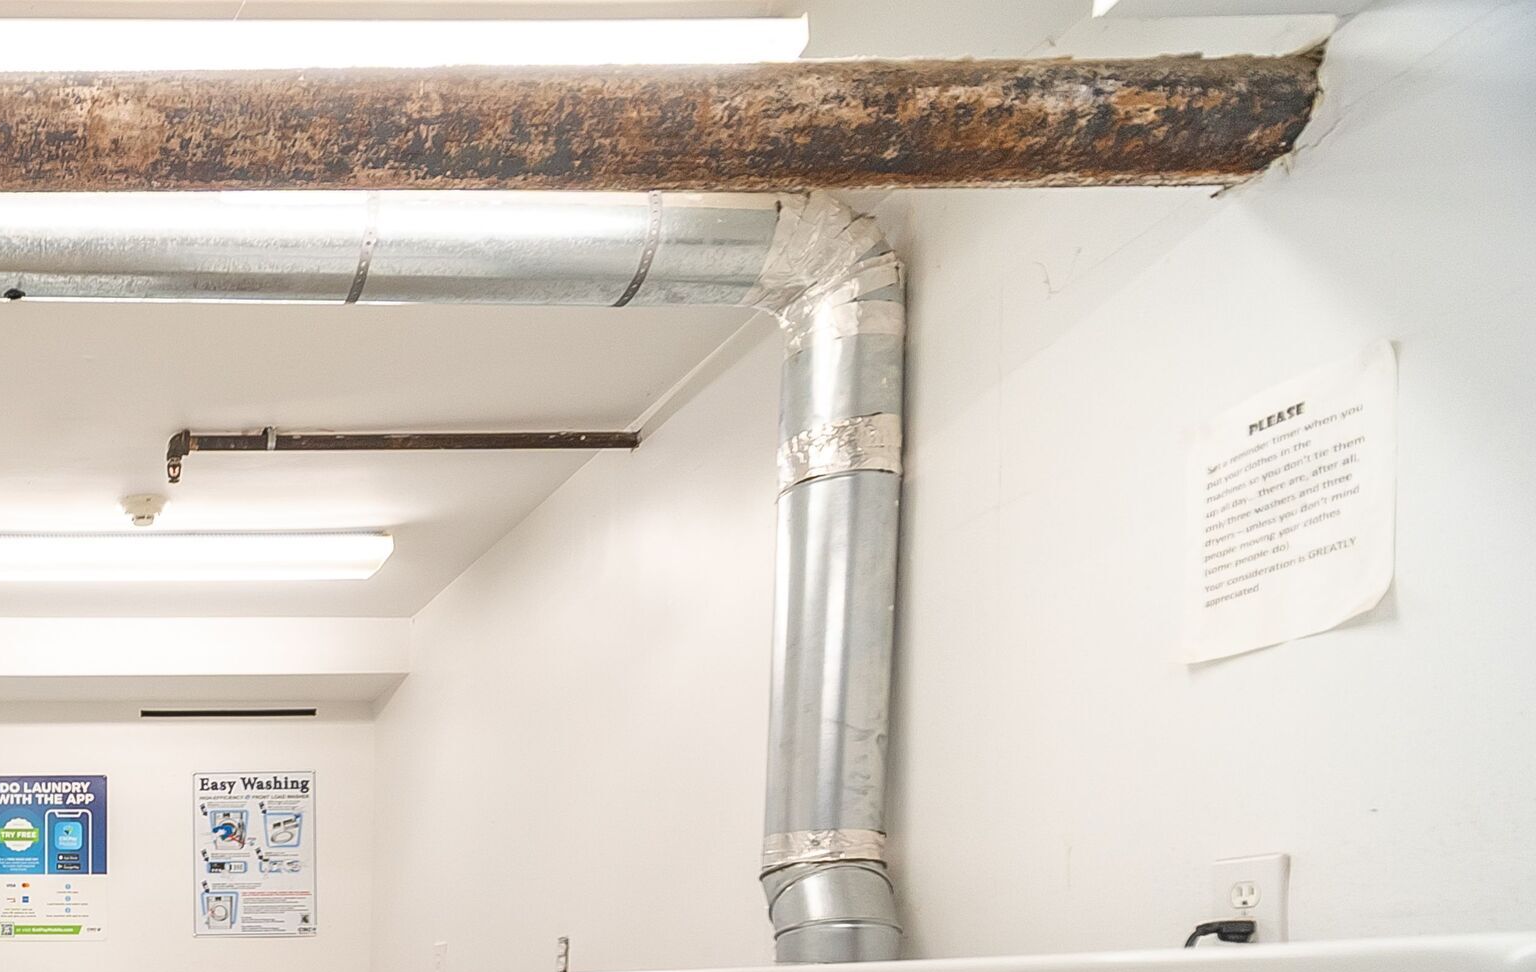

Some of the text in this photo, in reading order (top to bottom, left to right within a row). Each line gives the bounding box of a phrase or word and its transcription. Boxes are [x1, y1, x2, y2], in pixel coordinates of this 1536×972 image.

[1230, 439, 1270, 465] reminder
[1272, 428, 1300, 444] timer
[1304, 414, 1337, 431] when
[1341, 404, 1363, 421] you
[1248, 401, 1306, 436] PLEASE
[1206, 439, 1311, 490] put your clothes in the
[1206, 482, 1247, 504] machines
[1262, 468, 1281, 481] you
[1284, 455, 1311, 470] don't
[1315, 447, 1329, 460] tie
[1333, 436, 1365, 452] them
[1258, 481, 1286, 497] there
[1289, 474, 1309, 485] are,
[1312, 462, 1339, 477] after
[1342, 454, 1360, 466] all,
[1205, 473, 1352, 533] only three washers and three
[1205, 532, 1235, 547] dryers
[1246, 517, 1276, 533] unless
[1279, 509, 1298, 522] you
[1300, 497, 1327, 513] don't
[1331, 485, 1360, 501] mind
[1205, 509, 1341, 563] people moving your clothes
[1205, 541, 1290, 577] (some people do)
[1205, 536, 1357, 593] Your consideration is GREATLY
[1205, 584, 1260, 608] appreciated
[0, 782, 90, 793] DO LAUNDRY
[36, 794, 63, 804] THE
[66, 794, 95, 804] APP
[199, 776, 310, 794] Easy Washing
